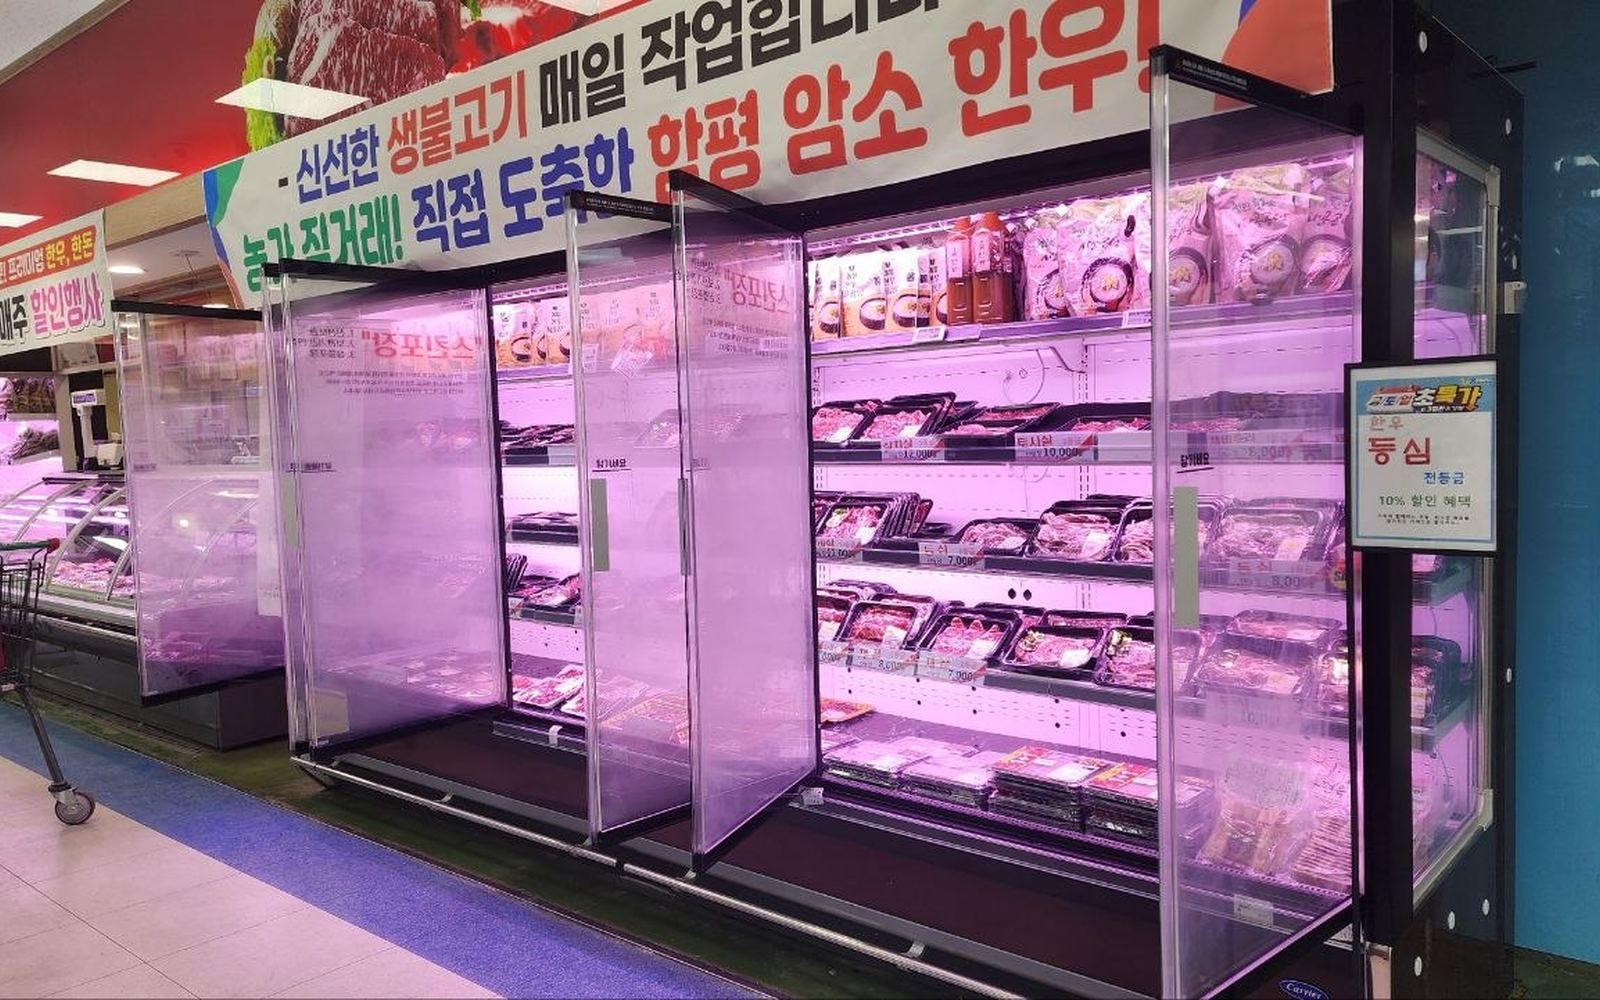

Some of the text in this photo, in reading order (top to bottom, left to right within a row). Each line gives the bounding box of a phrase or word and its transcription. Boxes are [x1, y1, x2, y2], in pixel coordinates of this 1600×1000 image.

[296, 124, 380, 204] 신선한
[387, 69, 528, 175] 생불고기
[539, 34, 626, 129] 매일
[640, 0, 940, 92] 작업합니
[243, 222, 295, 292] 농가
[299, 193, 404, 265] 직거래!
[411, 168, 490, 252] 직접
[647, 89, 761, 208] 함평
[783, 50, 929, 176] 암소
[948, 0, 1161, 137] 한우!
[7, 247, 44, 281] 프리미엄
[45, 240, 70, 270] 한우,
[71, 230, 94, 262] 한돈
[0, 294, 28, 341] 매주
[30, 270, 102, 336] 할인행사
[1367, 437, 1431, 466] 등심
[1424, 471, 1464, 485] 전등급
[1379, 494, 1472, 508] 10% 할인 혜택
[1286, 982, 1324, 1000] Carrier
